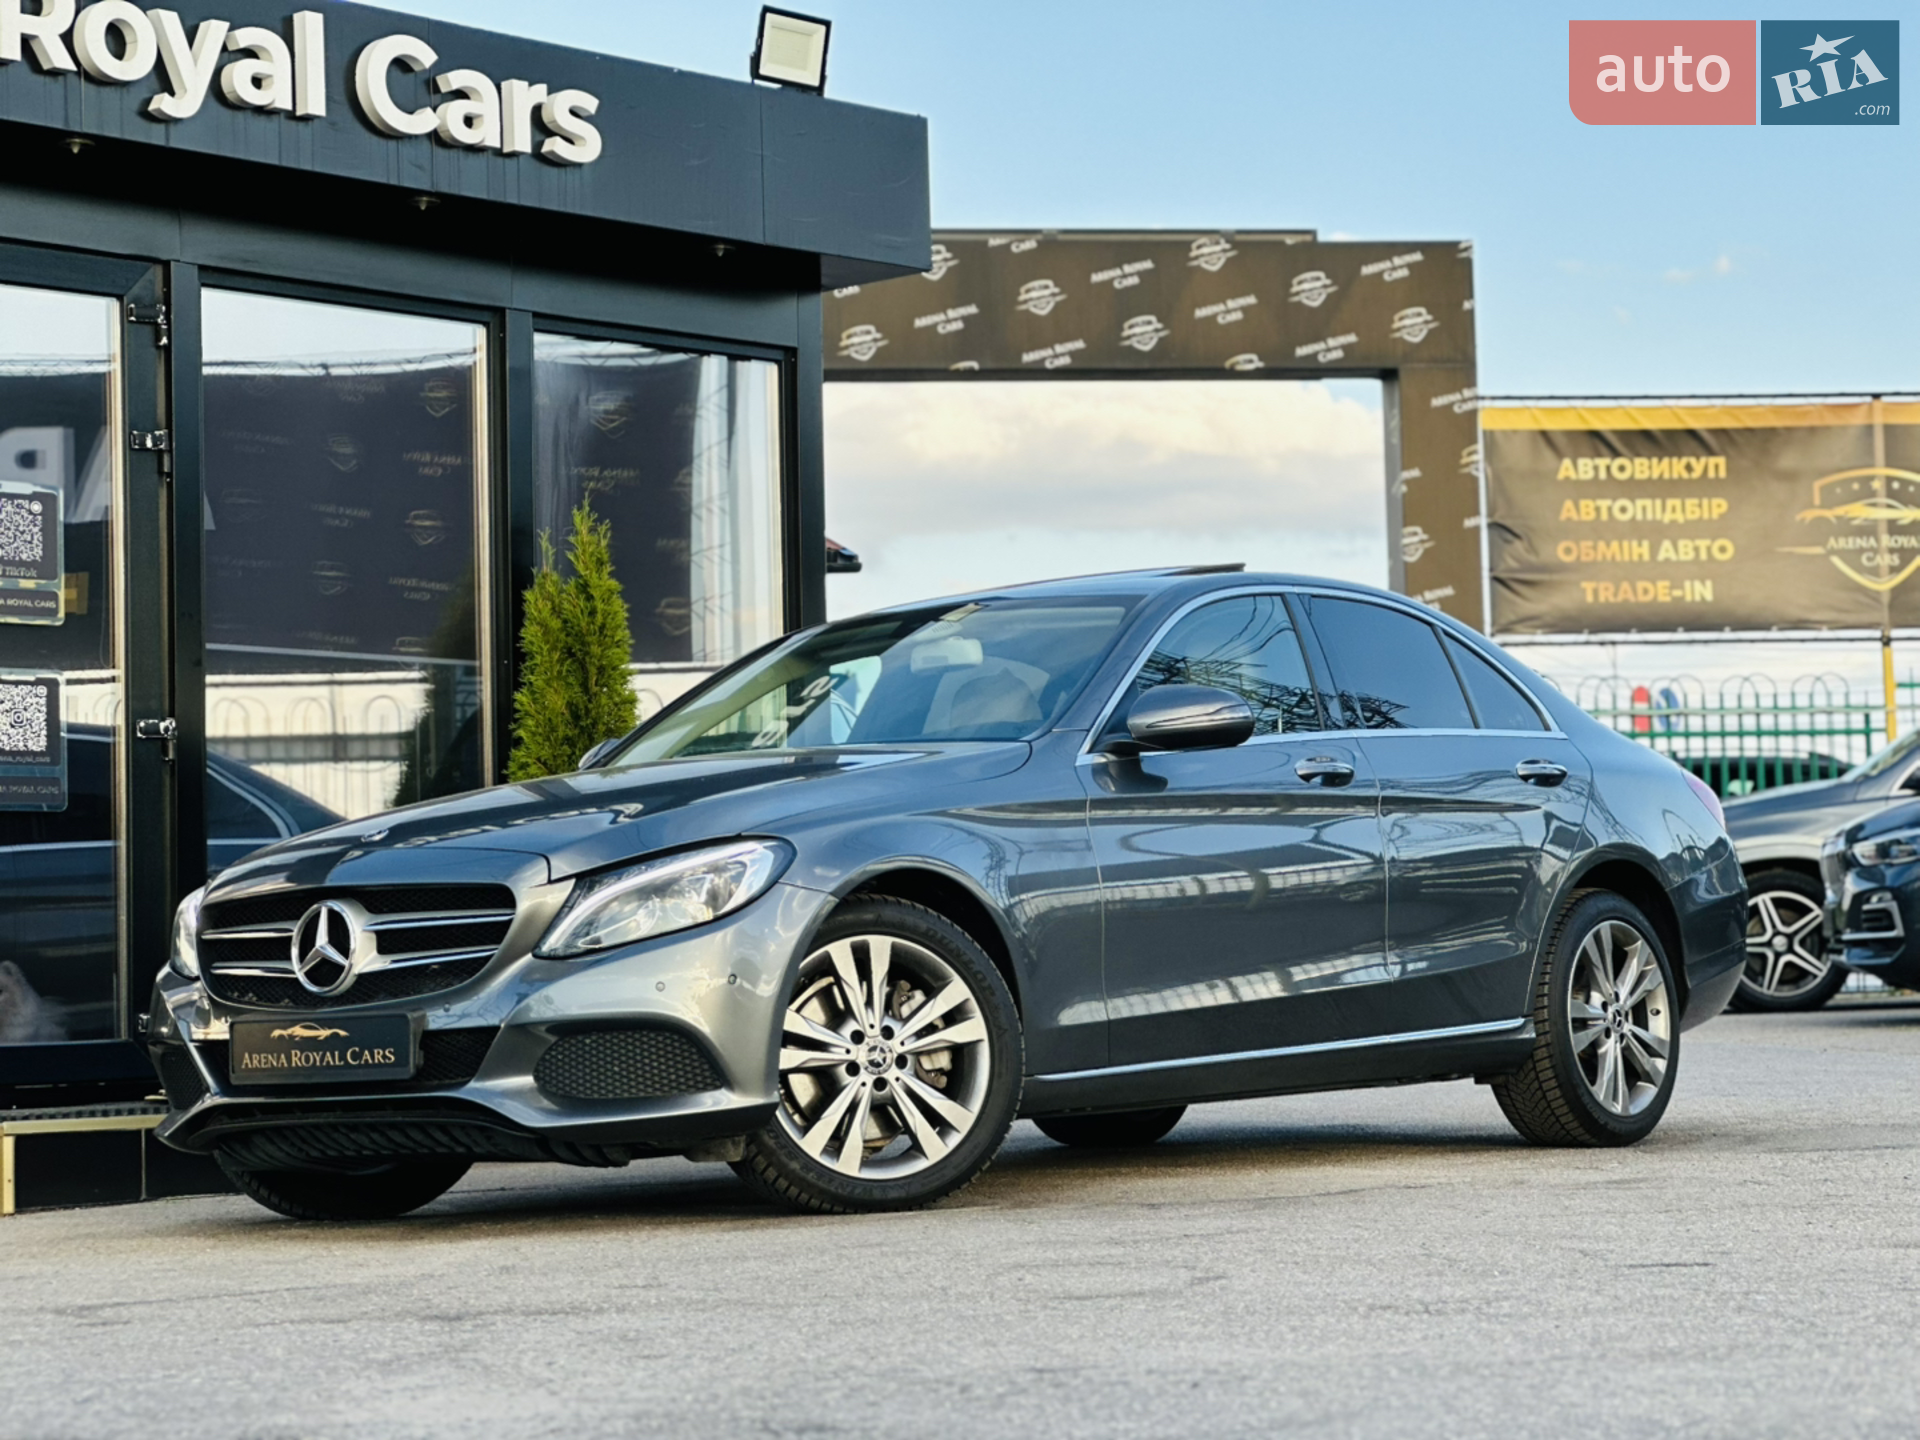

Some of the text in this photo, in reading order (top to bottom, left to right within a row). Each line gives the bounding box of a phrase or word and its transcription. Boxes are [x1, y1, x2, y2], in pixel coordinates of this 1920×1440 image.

[0, 0, 602, 165] Royal Cars
[1557, 456, 1727, 480] АВТОВИКУП
[1559, 498, 1728, 523] АВТОПІДБІР
[1556, 538, 1735, 562] ОБМІН АВТО
[1826, 535, 1877, 550] ARENA
[1860, 552, 1901, 567] CARS
[6, 598, 33, 608] ROYAL
[1581, 580, 1713, 603] TRADE-IN
[923, 926, 998, 999] DUNLOP
[241, 1047, 396, 1069] ARENA ROYAL CARS
